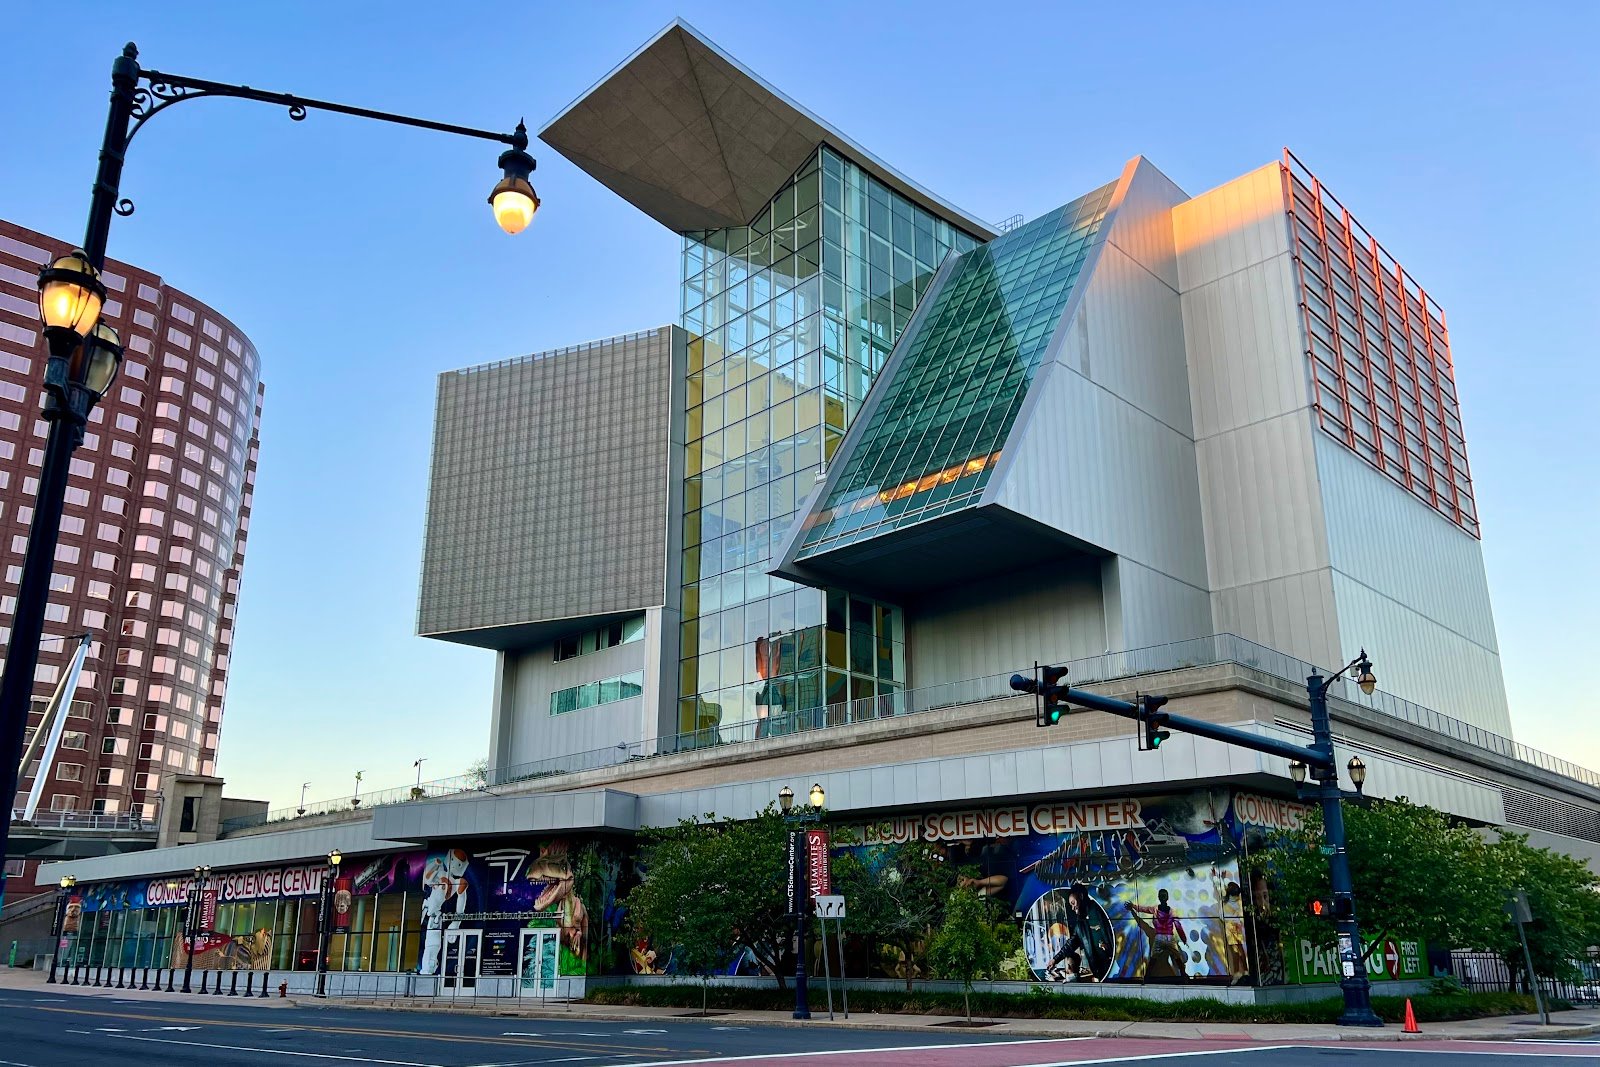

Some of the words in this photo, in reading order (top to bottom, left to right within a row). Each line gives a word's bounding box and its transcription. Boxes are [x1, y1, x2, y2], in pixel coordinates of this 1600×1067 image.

[926, 809, 1027, 839] SCIENCE
[1033, 802, 1140, 832] CENTER
[787, 831, 796, 914] www.CTScienceCenter.org
[808, 835, 821, 900] MUMMIES
[226, 870, 280, 900] SCIENCE
[1400, 941, 1418, 956] FIRST
[1402, 957, 1421, 974] LEFT
